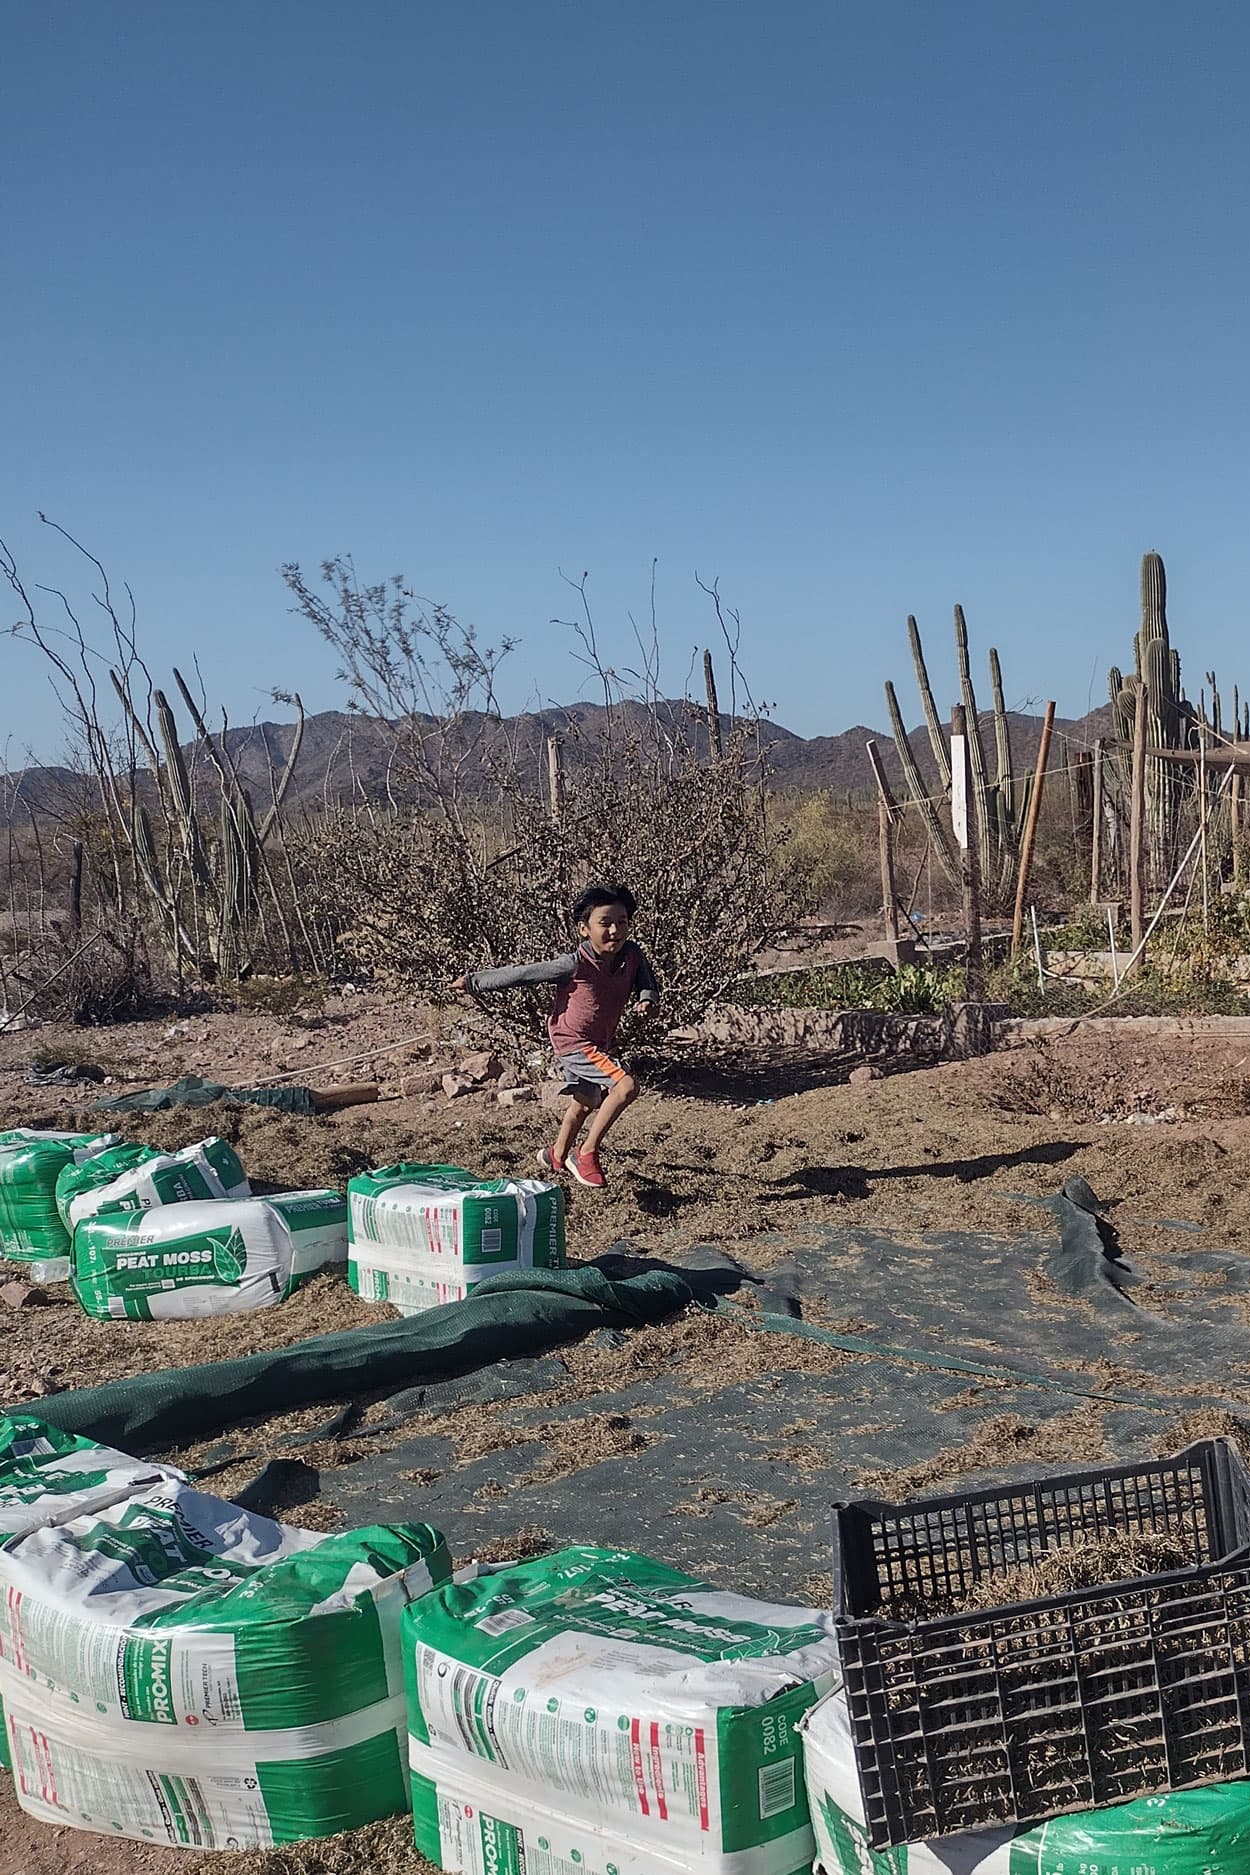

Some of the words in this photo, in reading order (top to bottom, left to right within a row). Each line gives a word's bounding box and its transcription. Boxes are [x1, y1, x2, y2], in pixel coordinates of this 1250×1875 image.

[106, 1234, 154, 1249] PREMIER
[547, 1196, 558, 1256] PREMIER
[116, 1254, 159, 1271] PEAT
[163, 1250, 213, 1265] MOSS
[142, 1264, 213, 1280] TOURBA
[585, 1592, 667, 1621] PEAT
[659, 1618, 751, 1644] MOSS
[203, 1680, 211, 1708] PREMIER
[761, 1716, 778, 1755] 0082
[777, 1714, 790, 1747] CODE
[637, 1777, 645, 1794] Use
[652, 1746, 665, 1799] Ingredients
[697, 1752, 706, 1808] Advantages
